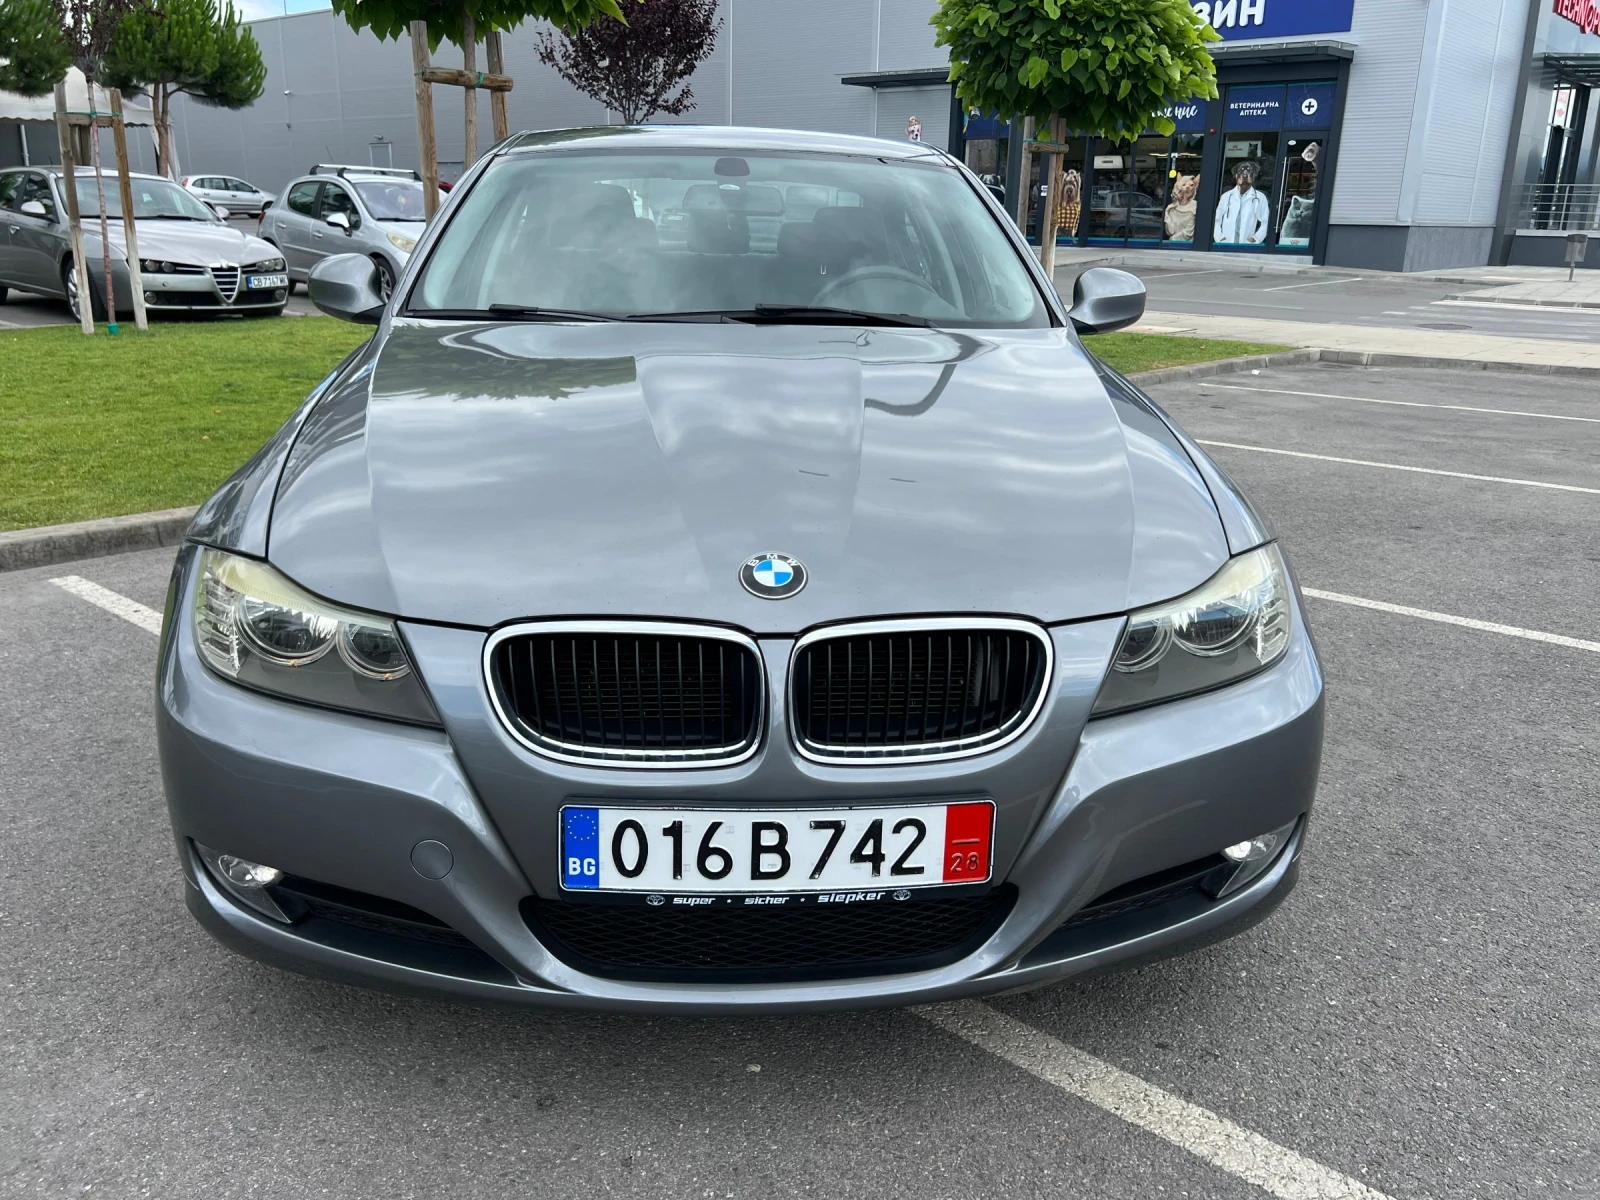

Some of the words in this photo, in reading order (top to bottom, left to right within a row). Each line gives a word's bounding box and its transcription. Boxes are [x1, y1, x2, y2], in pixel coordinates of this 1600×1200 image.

[1230, 101, 1279, 110] ВЕТЕРИНАРНА
[747, 554, 798, 567] BMW
[611, 819, 733, 880] 016
[750, 821, 791, 881] B
[809, 817, 927, 879] 742
[568, 857, 596, 876] BG
[950, 851, 979, 872] 28
[673, 897, 716, 906] super
[744, 896, 790, 905] sicher
